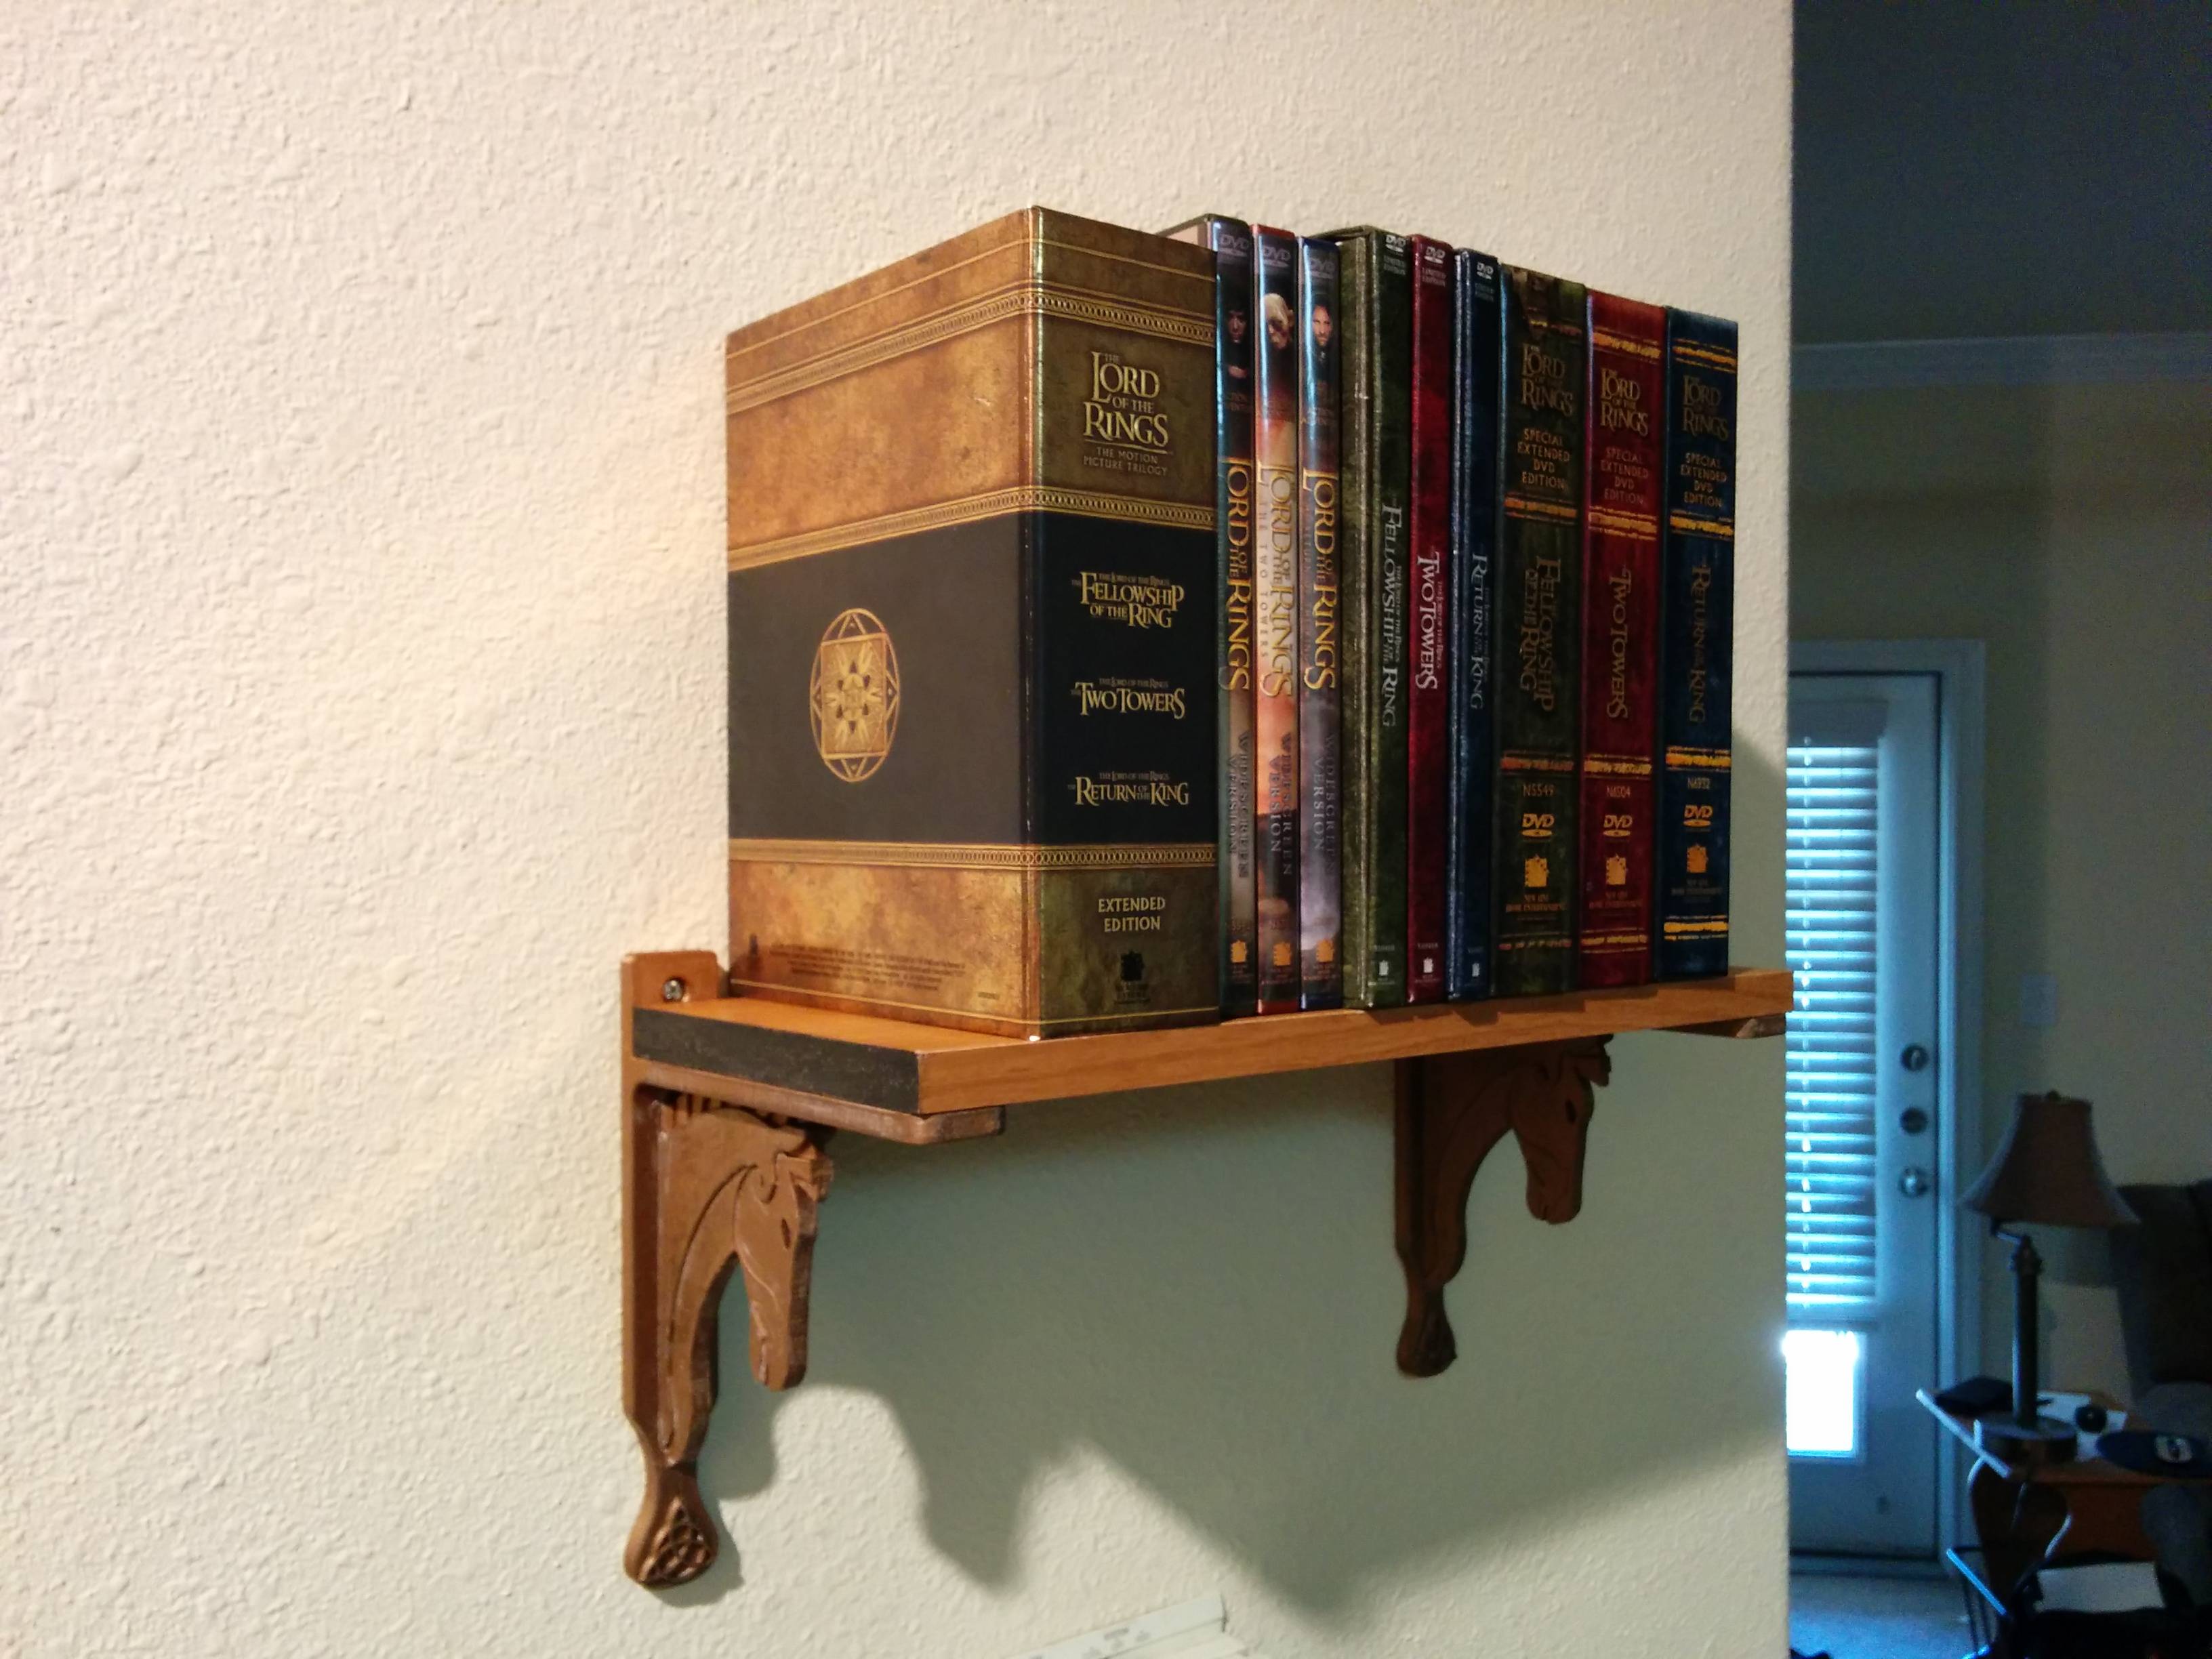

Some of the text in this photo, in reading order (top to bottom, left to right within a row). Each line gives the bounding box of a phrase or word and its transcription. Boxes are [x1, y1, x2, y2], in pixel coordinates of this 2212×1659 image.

[1220, 234, 1249, 250] DVD
[1264, 246, 1291, 261] DVD
[1426, 247, 1446, 259] DVD
[1091, 351, 1160, 403] LORD
[1521, 342, 1565, 379] LORD
[1601, 368, 1640, 402] LORD
[1683, 374, 1721, 407] LORD
[1112, 396, 1154, 413] OF THE
[1600, 401, 1648, 436] RINGS
[1084, 401, 1168, 448] RINGS
[1523, 428, 1563, 445] SPECIAL
[1683, 407, 1727, 441] RINGS
[1118, 450, 1158, 464] MOTION
[1517, 441, 1571, 462] EXTENDED
[1534, 460, 1555, 473] DVD
[1605, 447, 1643, 463] SPECIAL
[1521, 472, 1566, 491] EDITION
[1601, 461, 1648, 480] EXTENDED
[1614, 476, 1635, 489] DVD
[1219, 456, 1252, 547] LORD
[1257, 462, 1295, 554] LORD
[1303, 468, 1338, 554] LORD
[1258, 544, 1269, 578] TWO
[1382, 504, 1402, 644] FELLOWSHIP
[1080, 571, 1185, 612] FELLOWSHIP
[1471, 553, 1488, 636] RETURN
[1090, 603, 1172, 629] OF THE RING
[1258, 591, 1270, 658] TOWERS
[1415, 551, 1440, 690] TWO TOWERS
[1219, 579, 1252, 691] RINGS
[1260, 586, 1294, 697] RINGS
[1303, 585, 1338, 690] RINGS
[1534, 556, 1561, 712] FELLOWSHIP
[1606, 569, 1632, 719] TWO TOWERS
[1519, 625, 1540, 691] RING
[1381, 666, 1398, 727] RING
[1471, 655, 1483, 710] KING
[1075, 682, 1185, 720] TWO TOWERS
[1075, 777, 1137, 806] RETURN
[1150, 782, 1189, 806] KING
[1269, 755, 1280, 853] VERSION
[1313, 756, 1324, 851] VERSION
[1522, 813, 1555, 830] DVD
[1603, 815, 1633, 829] DVD
[1683, 804, 1713, 819] DVD
[1098, 897, 1166, 913] EXTENDED
[1104, 916, 1161, 933] EDITION
